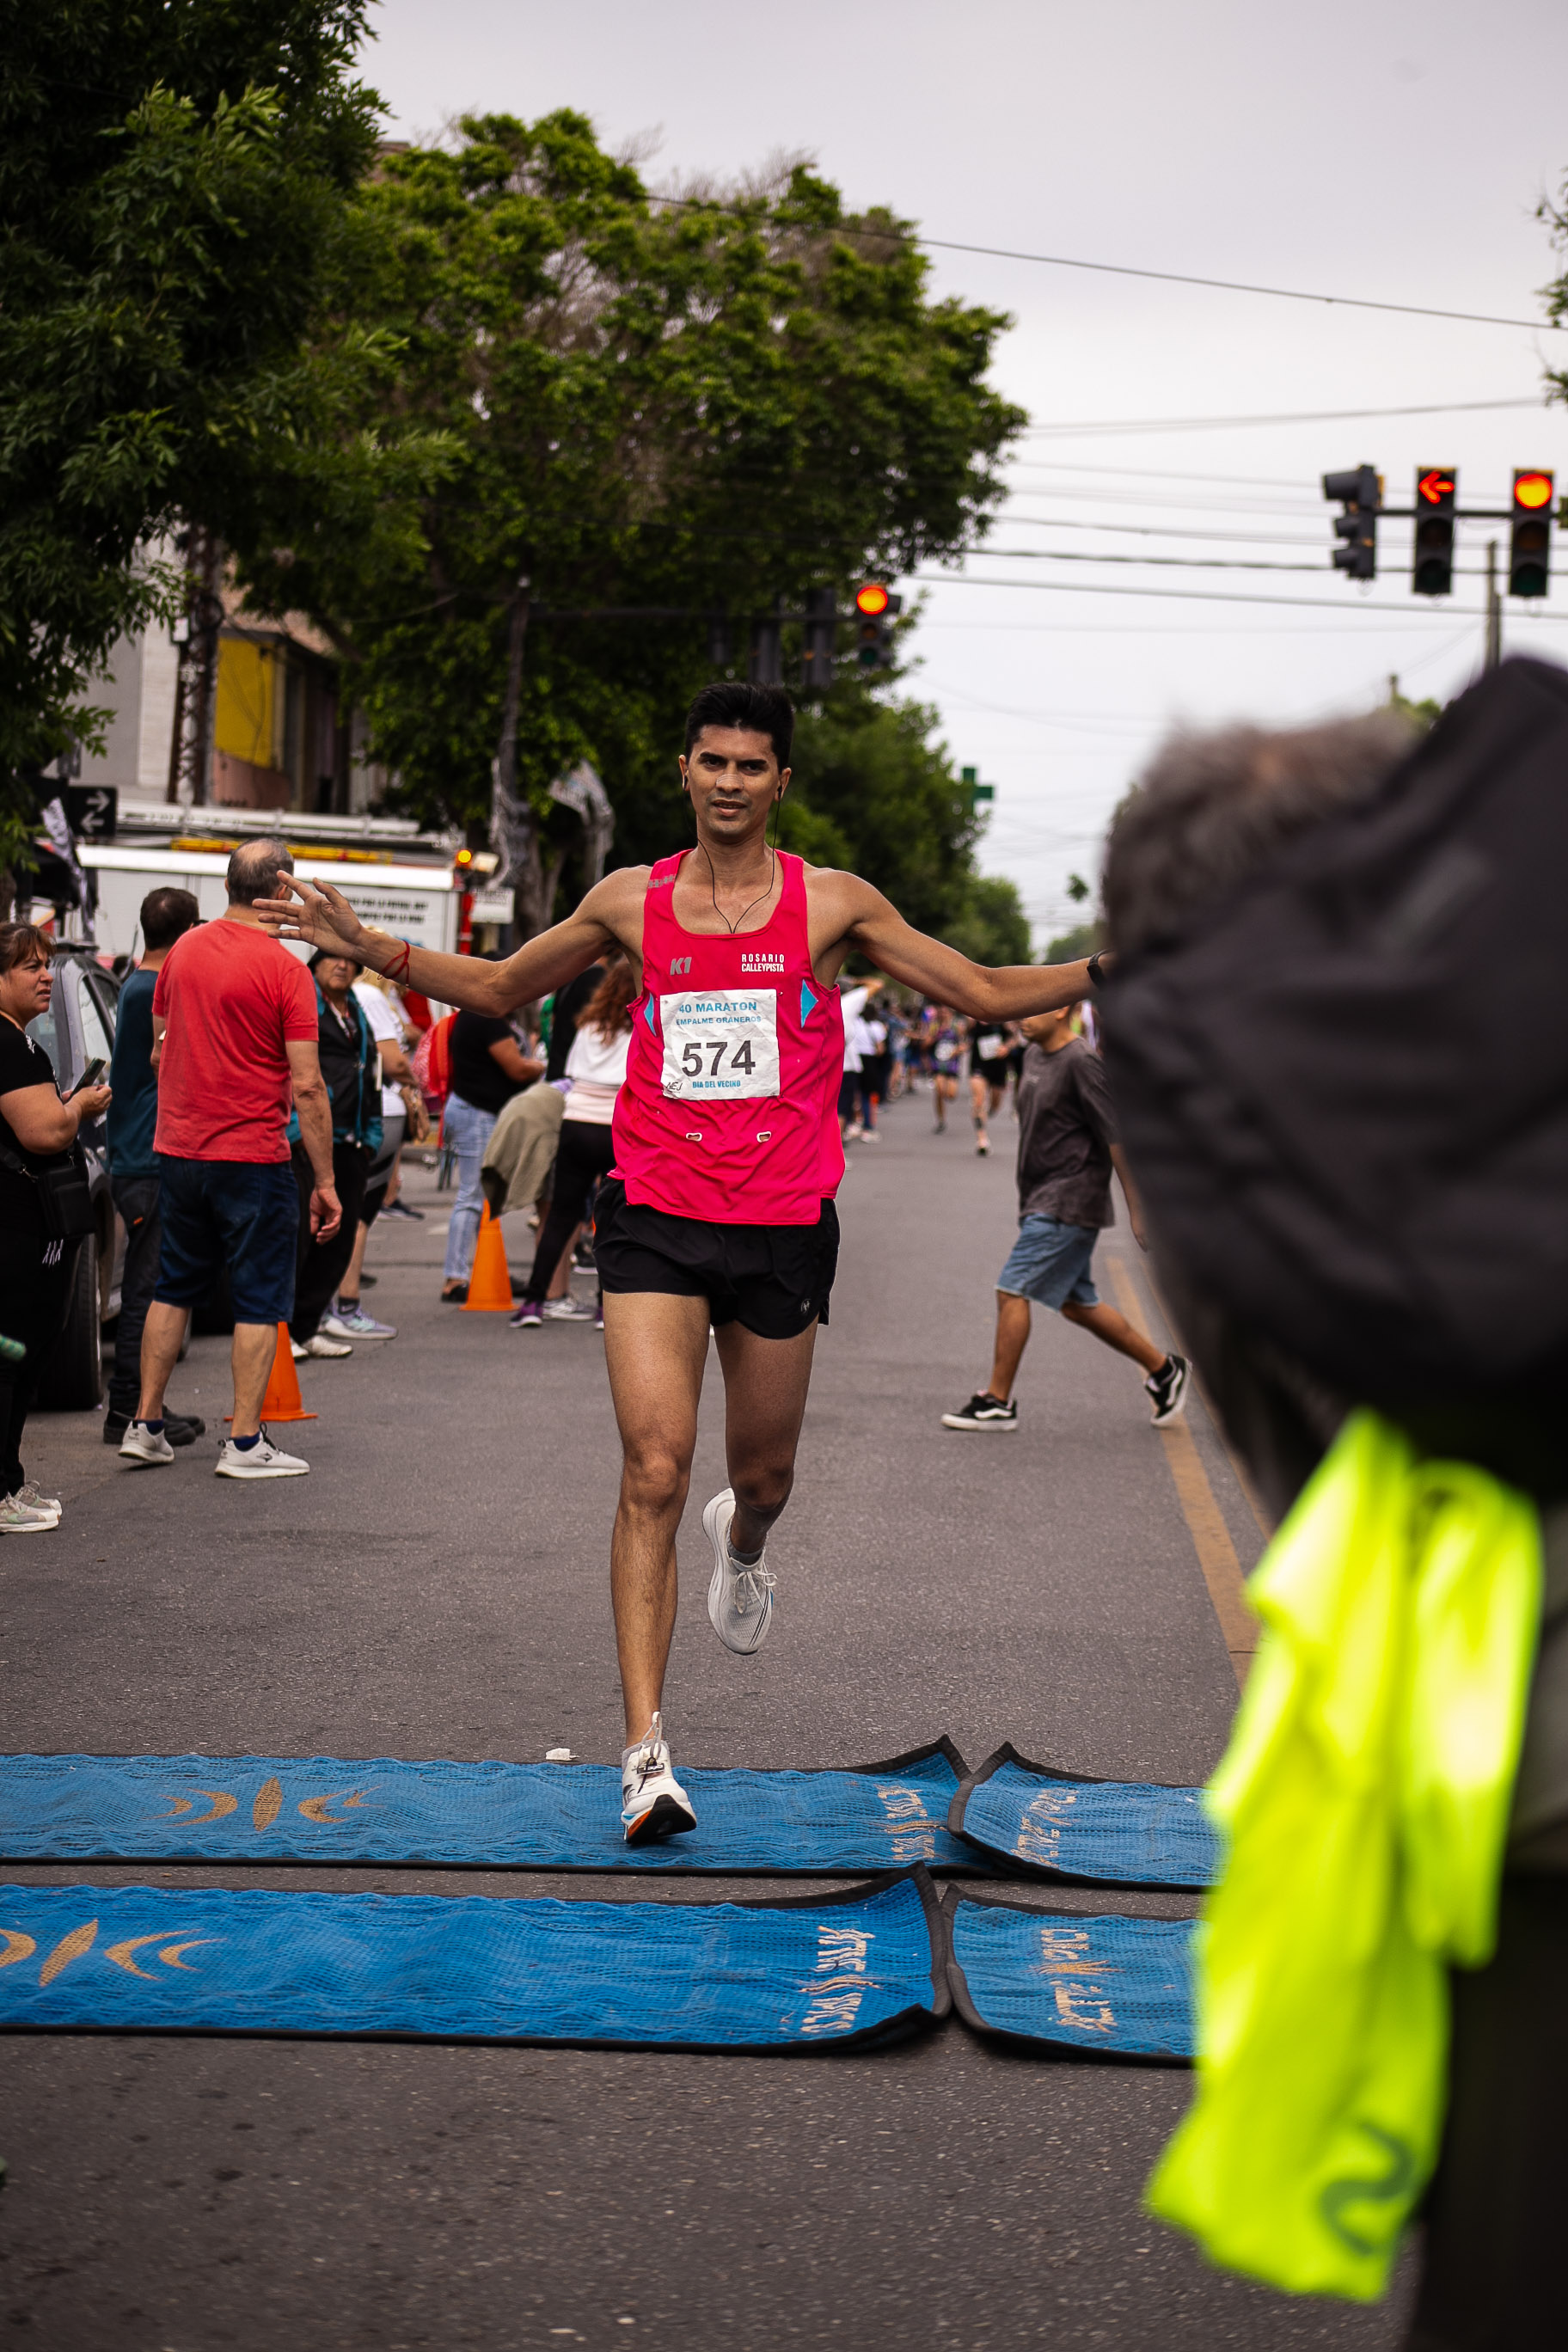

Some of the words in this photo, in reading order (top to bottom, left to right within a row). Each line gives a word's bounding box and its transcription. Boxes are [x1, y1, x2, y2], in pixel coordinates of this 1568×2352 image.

[742, 953, 785, 963] ROSARIO
[670, 957, 692, 976] K1
[742, 963, 785, 972] CALLEYPISTA
[679, 1004, 691, 1013] 40
[696, 1001, 756, 1012] MARATON
[682, 1040, 756, 1076] 574
